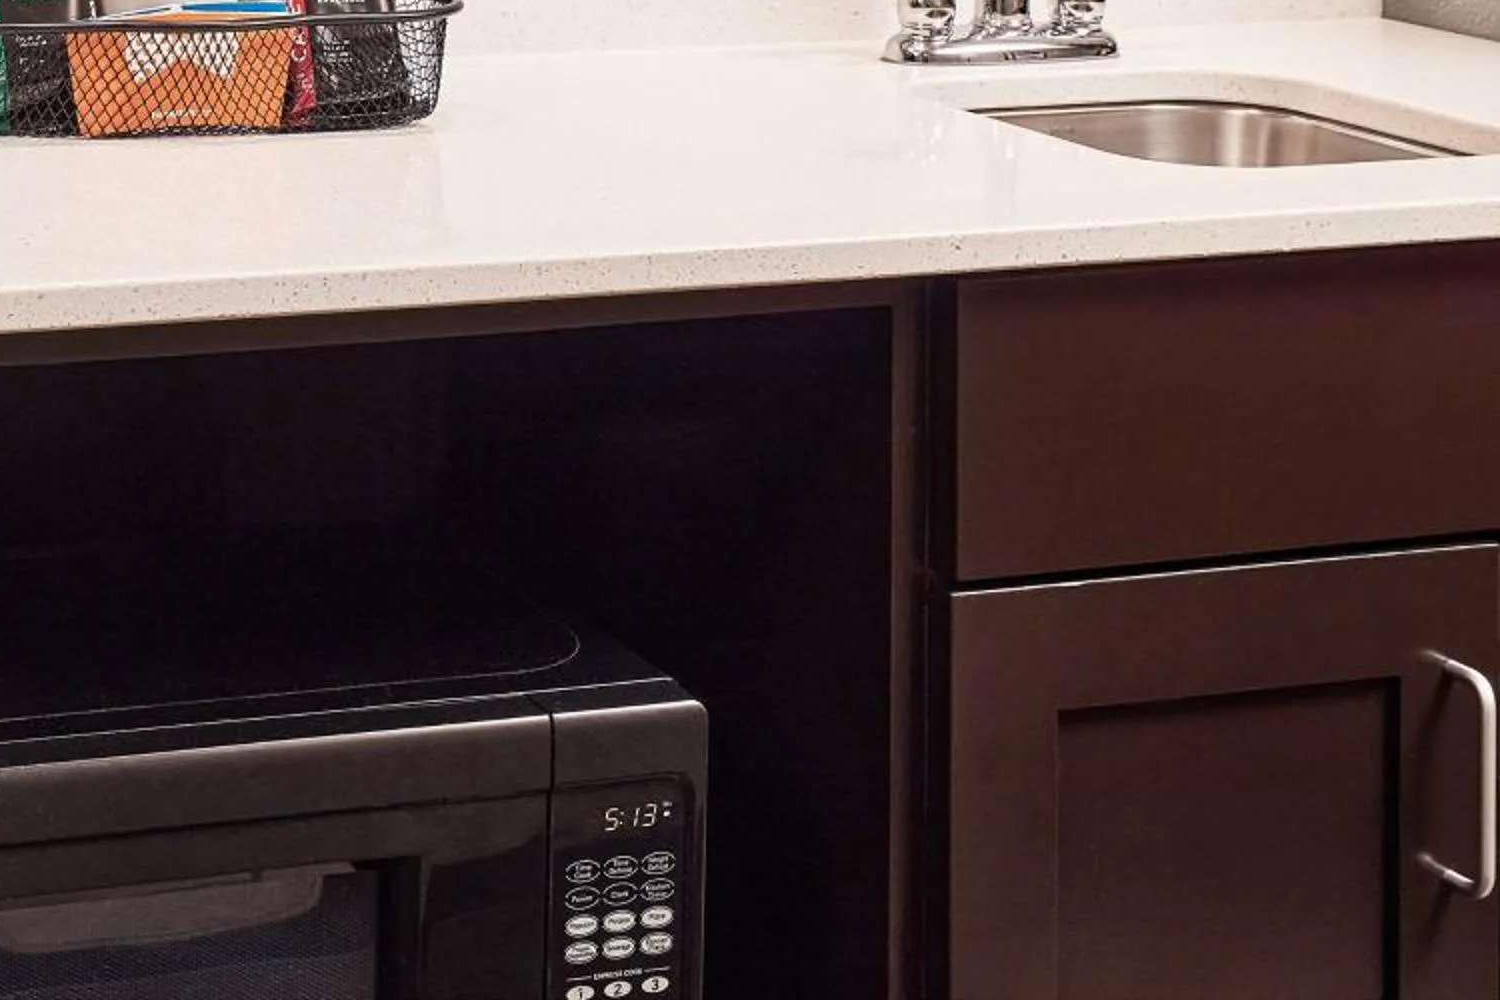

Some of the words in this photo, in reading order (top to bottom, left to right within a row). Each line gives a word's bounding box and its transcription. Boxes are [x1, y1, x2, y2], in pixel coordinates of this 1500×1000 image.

[604, 803, 658, 832] 5:13
[613, 983, 623, 997] 2
[651, 978, 660, 991] 3
